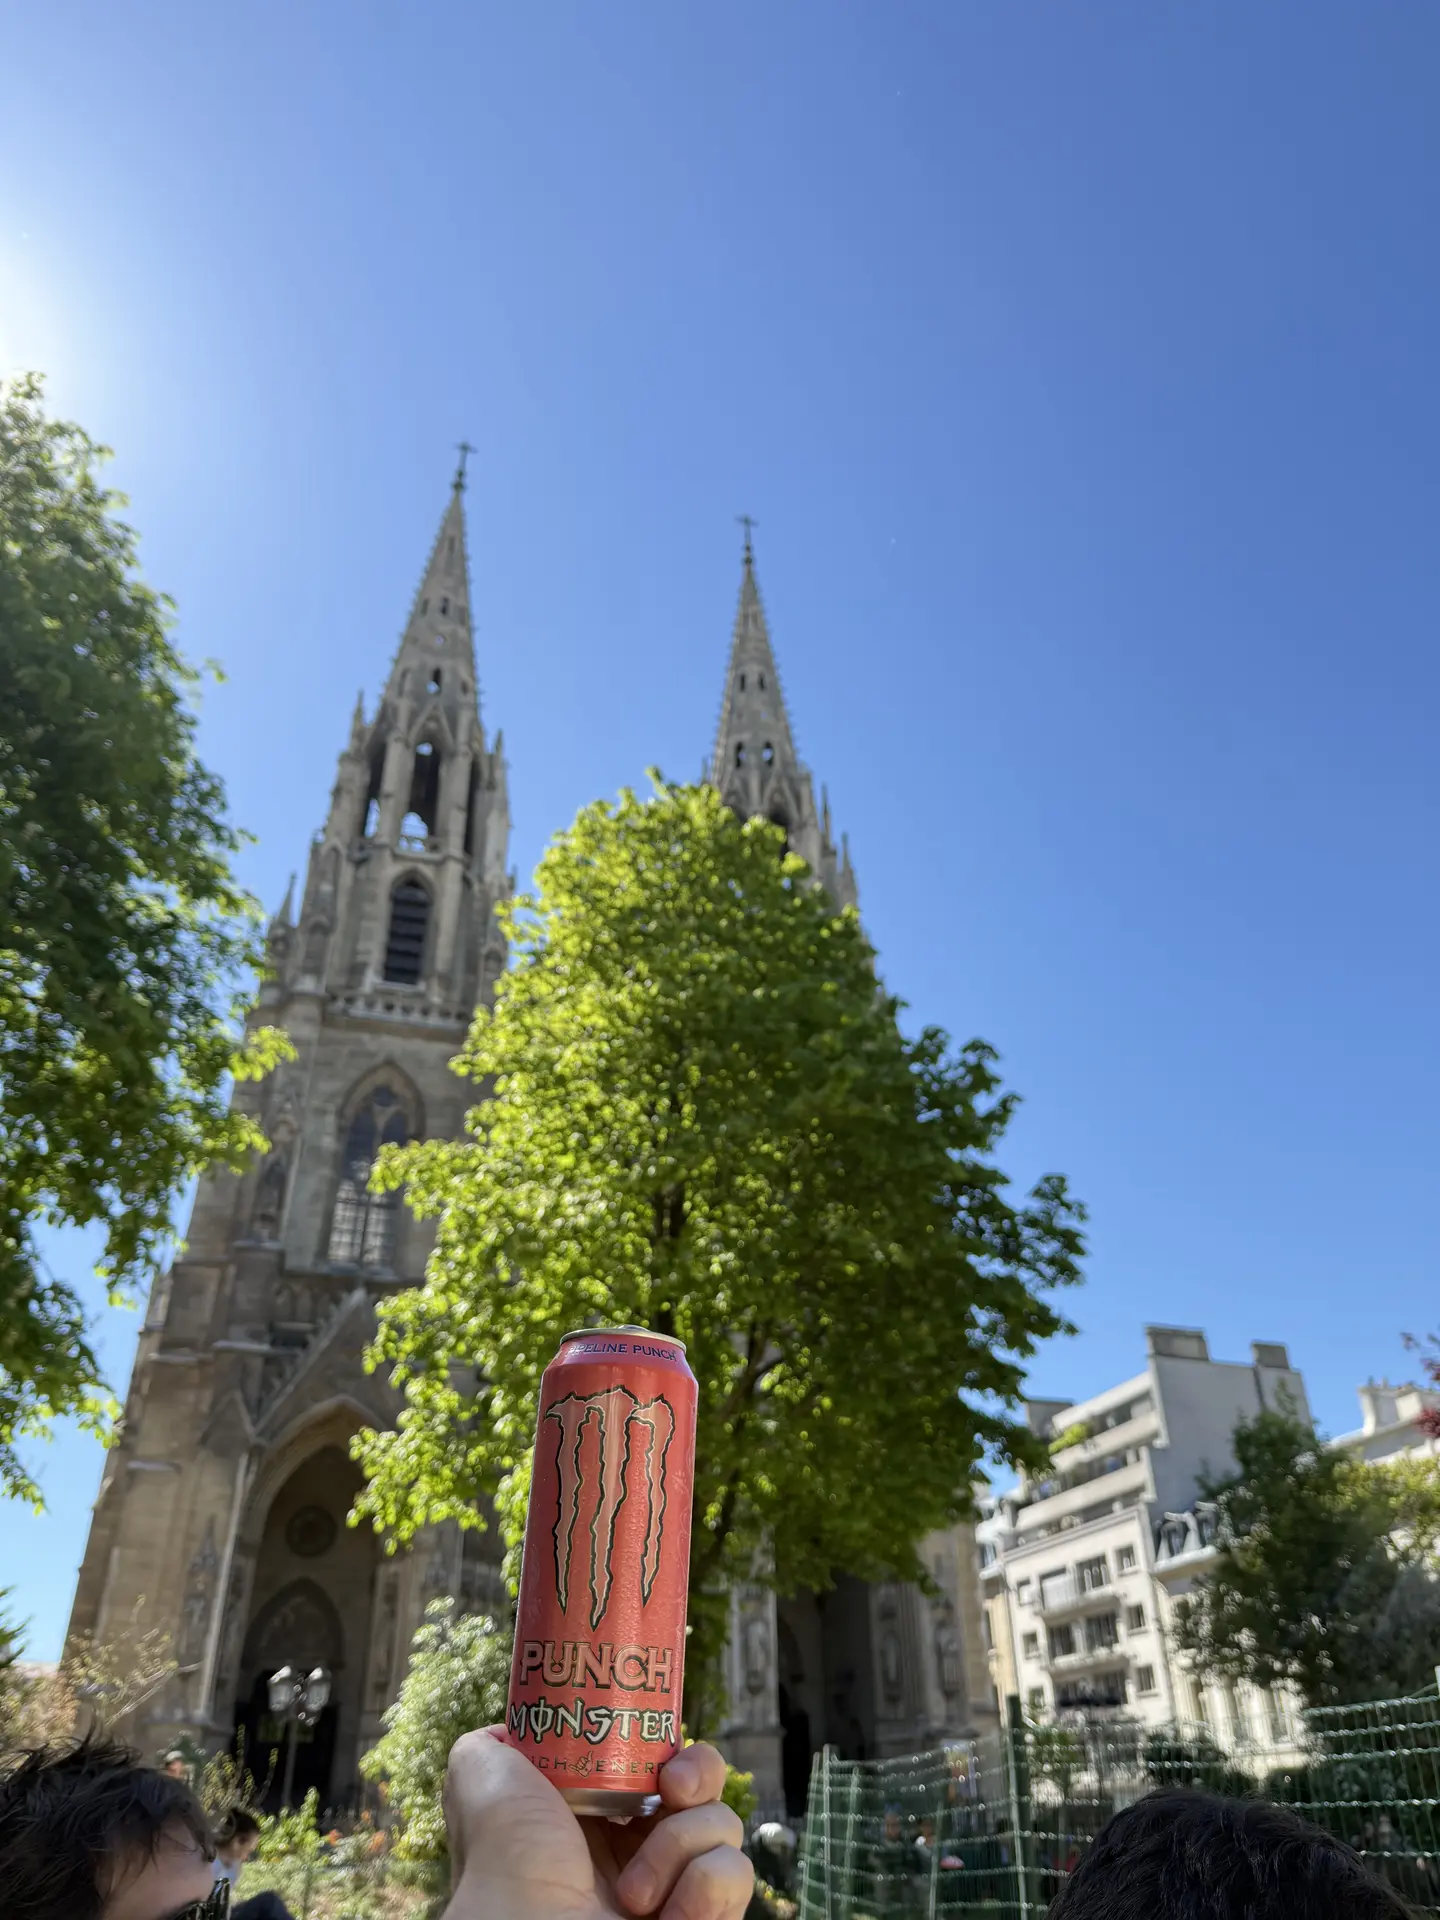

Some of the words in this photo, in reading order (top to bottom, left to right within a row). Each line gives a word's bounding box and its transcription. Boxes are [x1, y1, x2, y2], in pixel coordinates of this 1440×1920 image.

[632, 1344, 677, 1362] PUNCH
[519, 1640, 673, 1693] PUNCH
[508, 1696, 676, 1747] MONSTER
